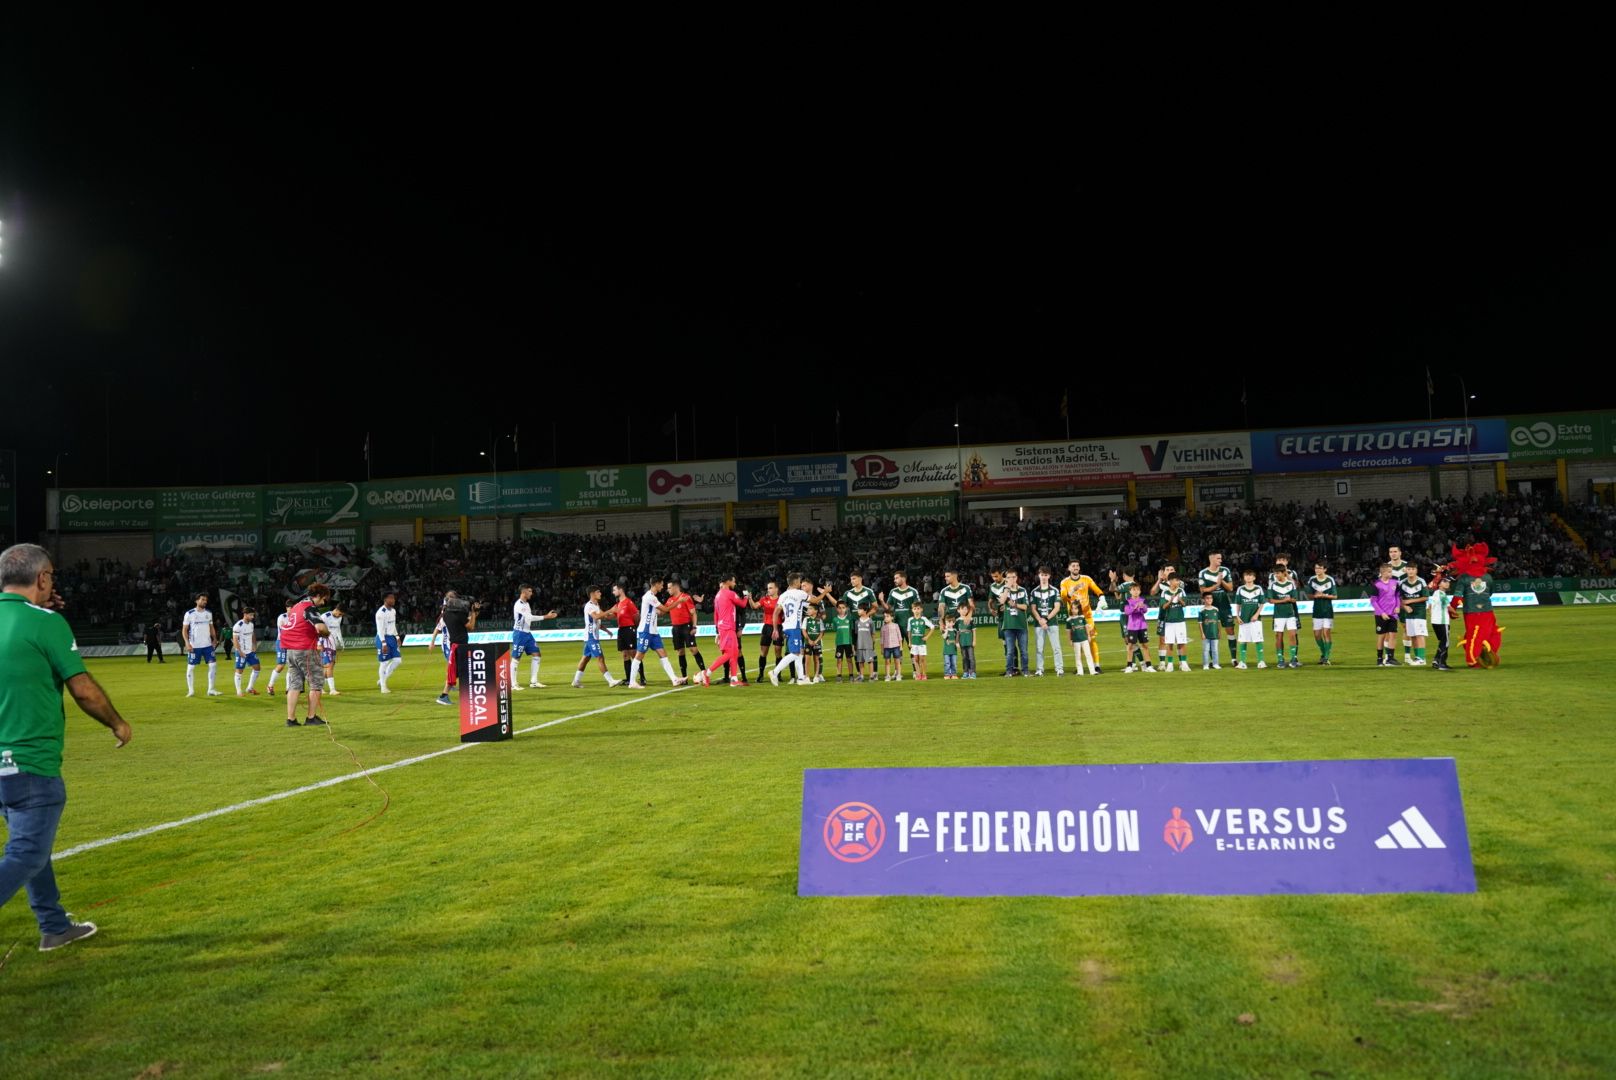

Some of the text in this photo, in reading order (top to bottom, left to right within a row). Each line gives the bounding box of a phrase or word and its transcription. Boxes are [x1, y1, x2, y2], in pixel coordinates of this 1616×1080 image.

[1281, 428, 1472, 455] ELECTROCASH
[1016, 444, 1104, 456] Sistemas Contra
[1173, 448, 1243, 462] VEHINCA
[1002, 452, 1120, 466] Incendios Madrid, S.L.
[1342, 456, 1412, 468] electrocash.es
[902, 460, 942, 473] Maestro
[586, 468, 620, 488] TCF
[694, 473, 736, 485] PLANO
[904, 470, 958, 482] embutido
[385, 488, 454, 504] RODYMAQ
[502, 488, 533, 496] HIERROS
[578, 490, 626, 499] SEGURIDAD
[83, 498, 154, 512] teleporte
[844, 496, 948, 512] Clínica Veterinaria
[784, 603, 794, 618] 16
[472, 650, 488, 726] GEFISCAL
[1195, 807, 1348, 834] VERSUS
[936, 803, 1140, 853] FEDERACIÓN
[1216, 837, 1336, 851] E-LEARNING
